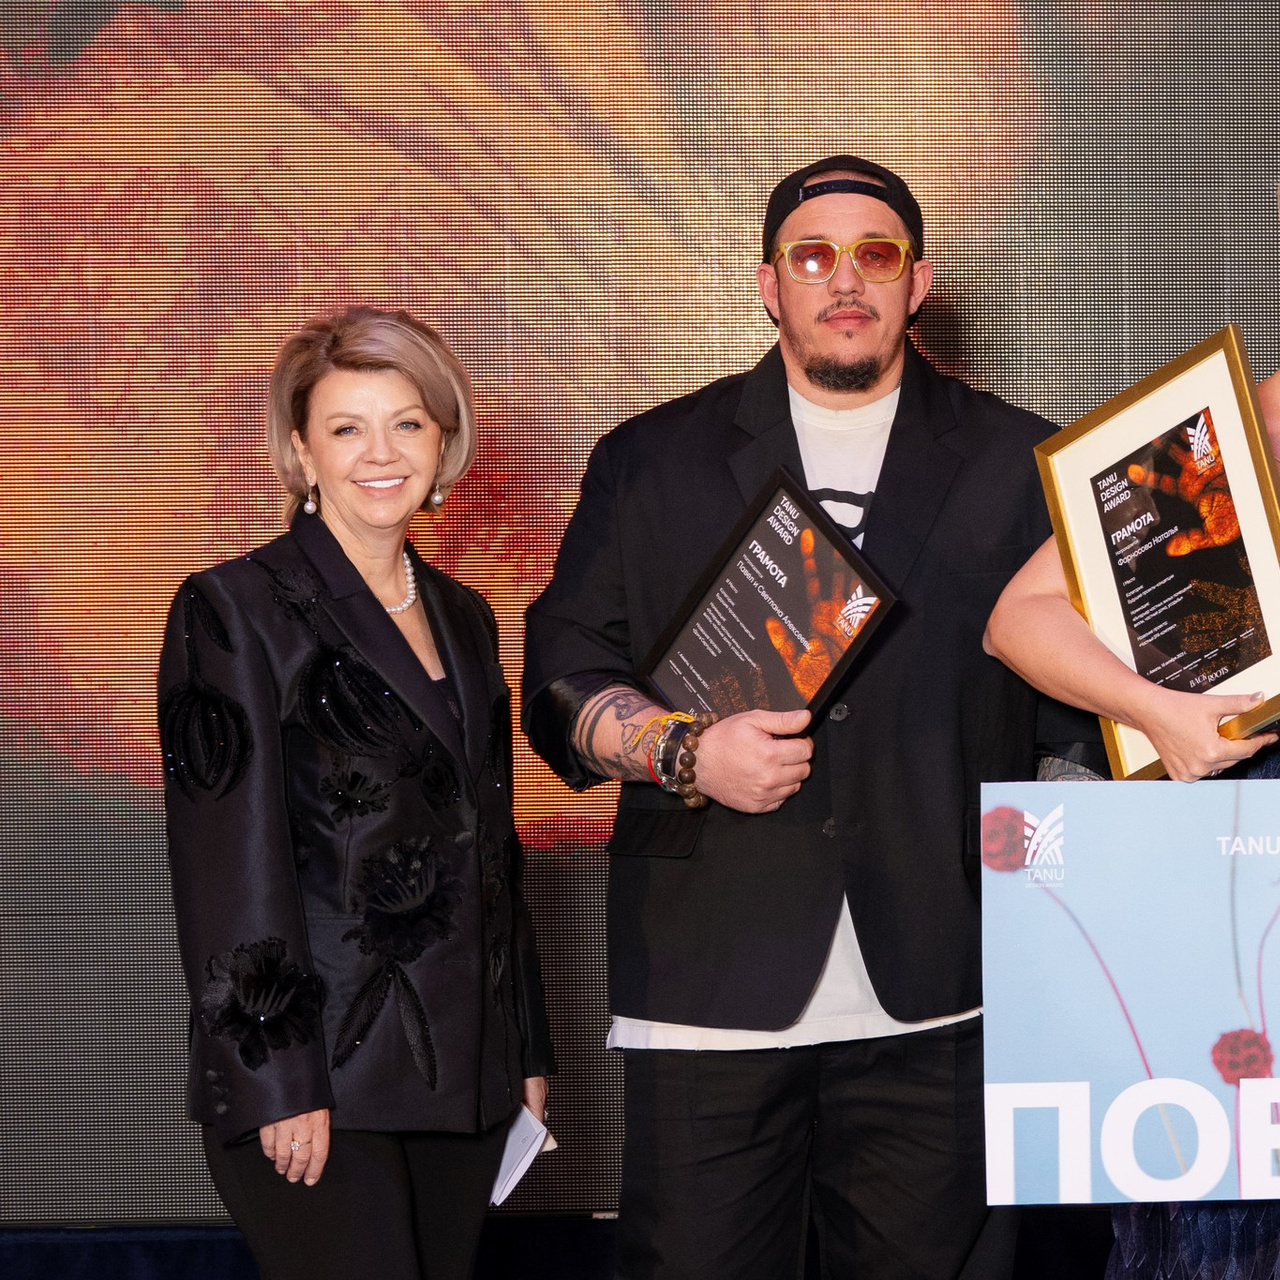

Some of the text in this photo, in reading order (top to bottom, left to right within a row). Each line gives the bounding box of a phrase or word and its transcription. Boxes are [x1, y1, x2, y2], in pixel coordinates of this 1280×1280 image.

[1196, 454, 1214, 469] TANU
[1097, 472, 1117, 490] TANU
[1100, 479, 1128, 501] DESIGN
[781, 496, 799, 519] TANU
[1104, 490, 1130, 512] AWARD
[767, 516, 792, 545] AWARD
[774, 506, 799, 536] DESIGN
[1111, 512, 1154, 544] ГРАМОТА
[1118, 526, 1178, 565] Фарносова Наталья
[749, 540, 787, 587] ГРАМОТА
[737, 561, 754, 583] Павел
[758, 585, 783, 617] Светлана
[782, 616, 811, 650] Алексеевы
[837, 614, 853, 636] TANU
[1216, 835, 1280, 856] TANU
[1024, 867, 1065, 881] TANU
